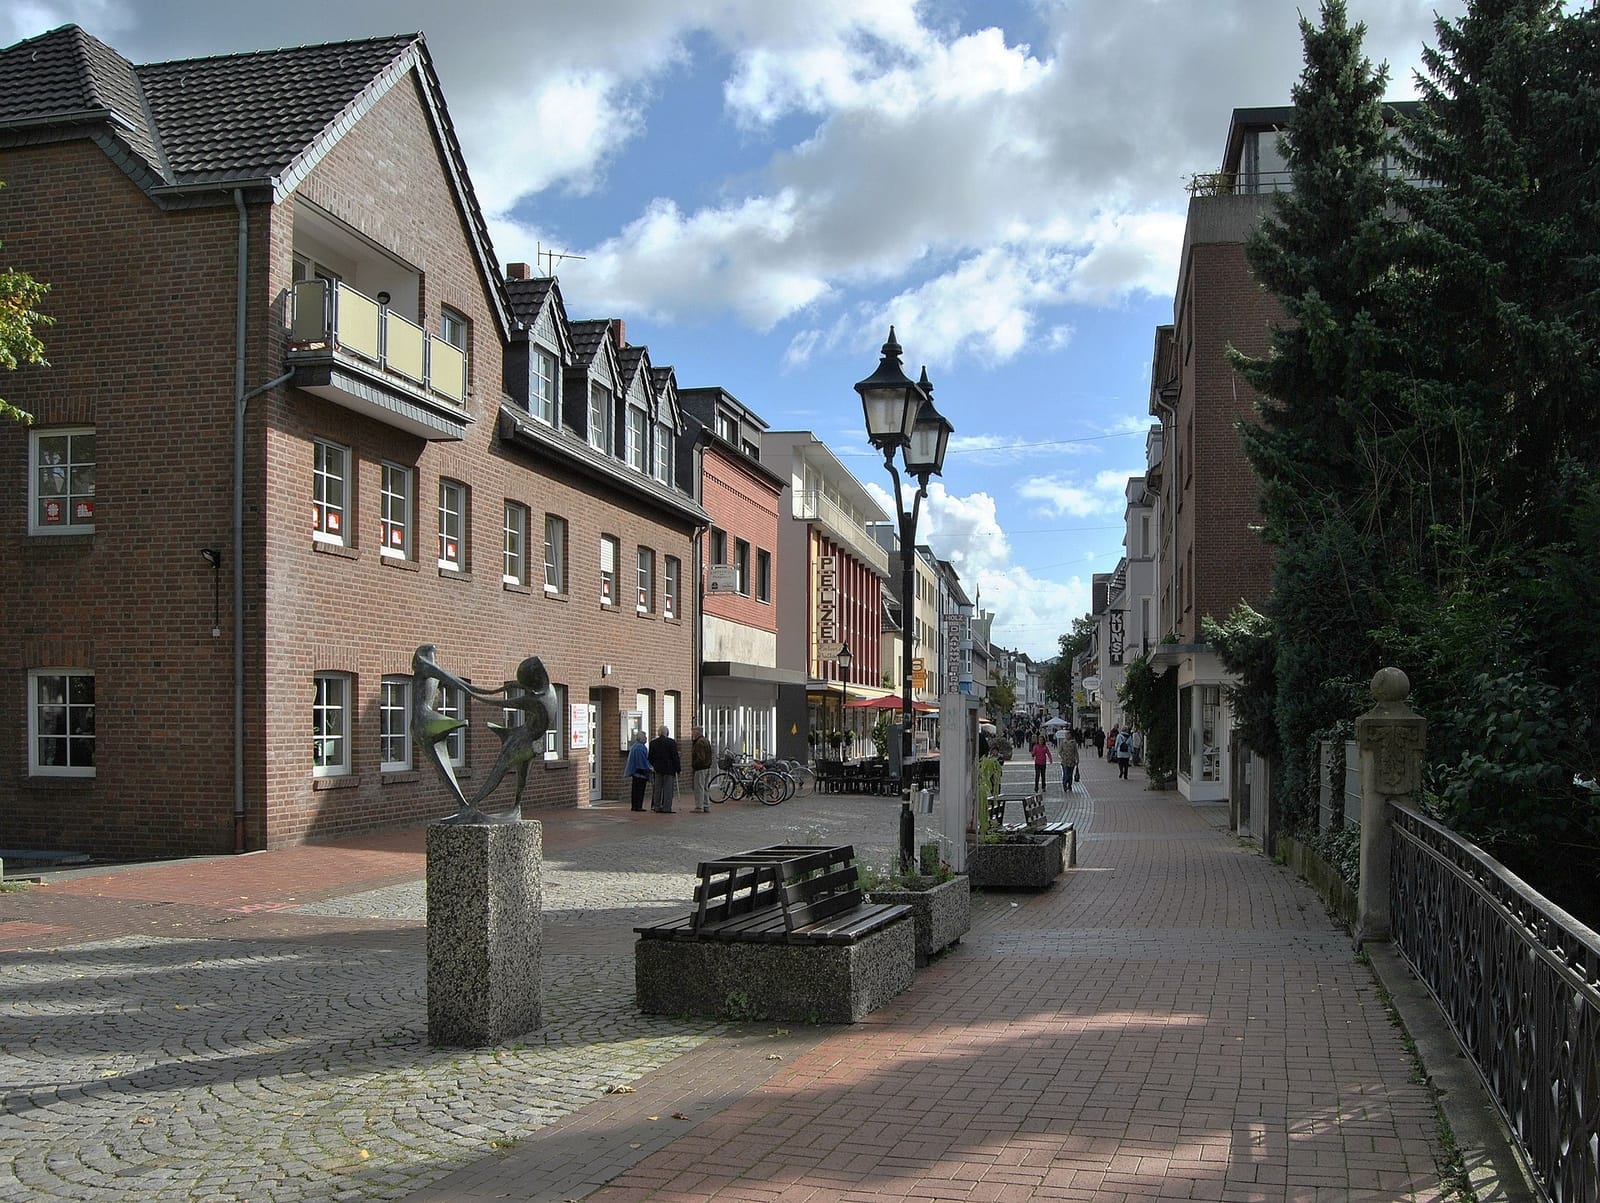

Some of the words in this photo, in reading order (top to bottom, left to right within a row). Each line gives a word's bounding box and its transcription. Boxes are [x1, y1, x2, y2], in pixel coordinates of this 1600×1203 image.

[820, 557, 833, 639] PELZE
[945, 614, 964, 622] HOLZ
[1111, 613, 1122, 661] KUNST
